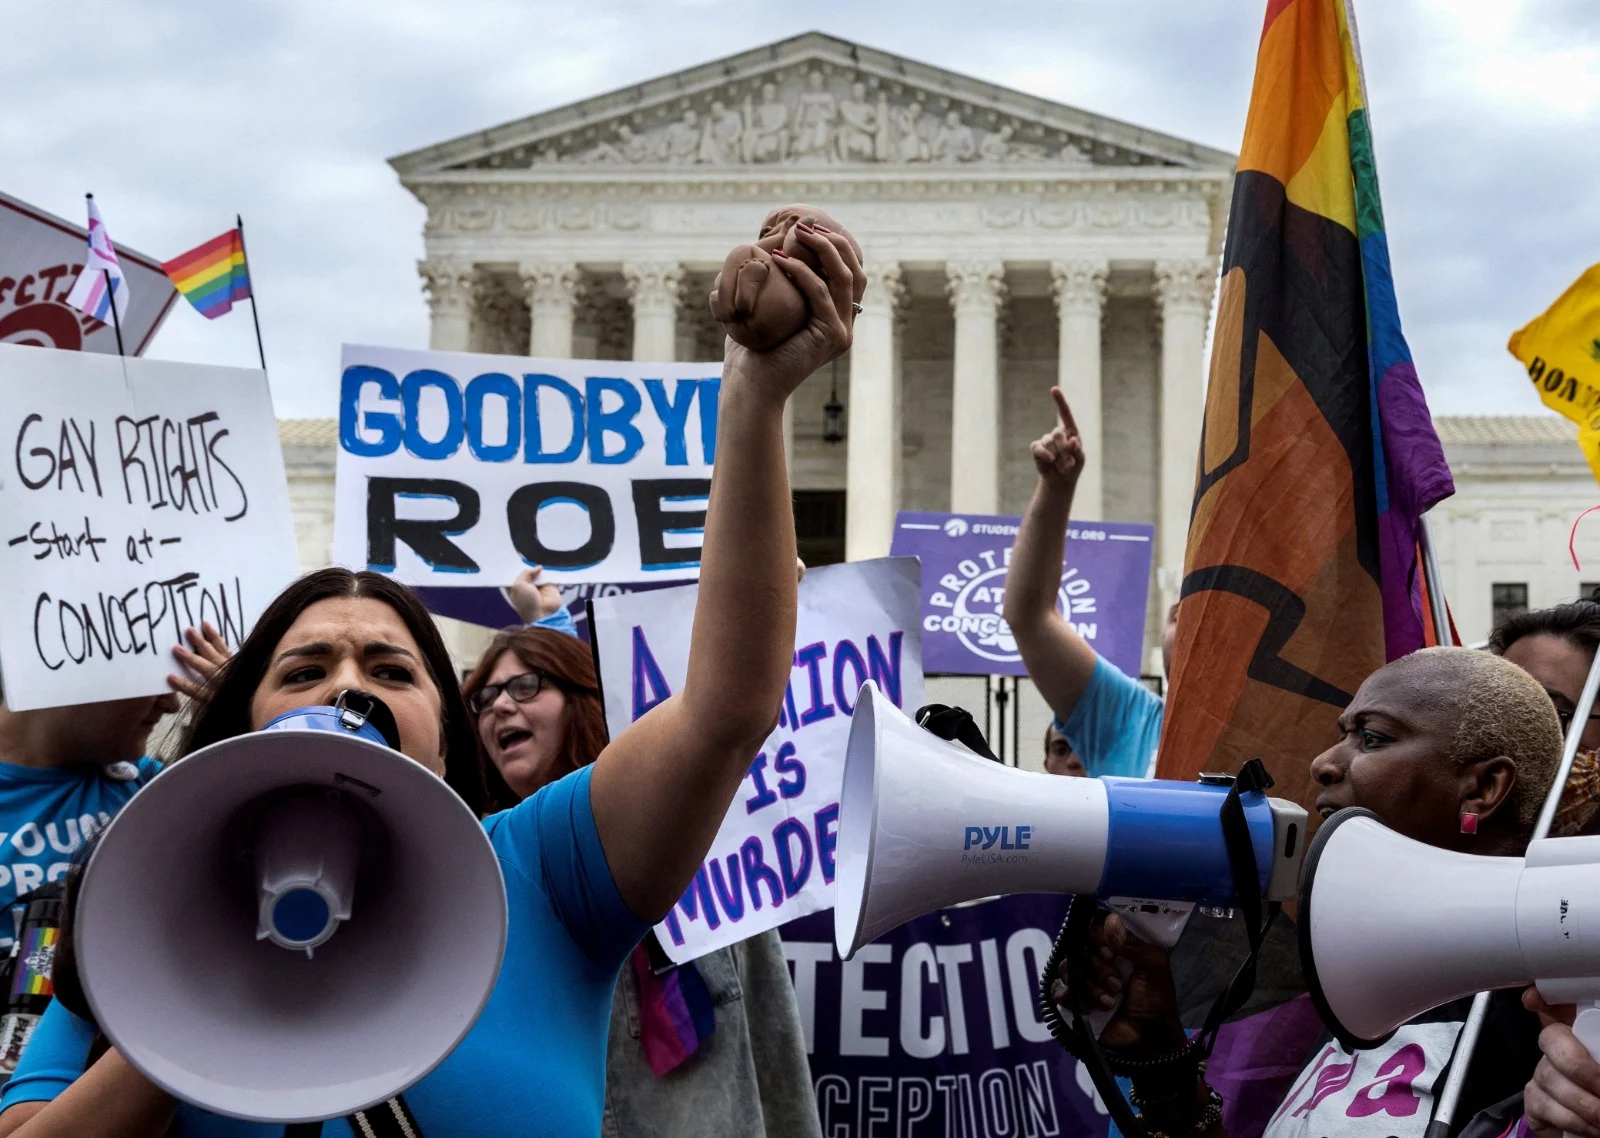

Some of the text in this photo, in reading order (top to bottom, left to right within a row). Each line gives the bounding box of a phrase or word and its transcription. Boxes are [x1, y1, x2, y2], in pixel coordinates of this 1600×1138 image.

[16, 411, 248, 522] GAY RIGHTS
[366, 475, 711, 574] ROE
[34, 573, 245, 670] CONCEPTION
[743, 742, 806, 815] IS
[962, 853, 1028, 868] PyleUSA.com
[964, 826, 1031, 850] PYLE
[815, 1060, 1060, 1138] CEPTION
